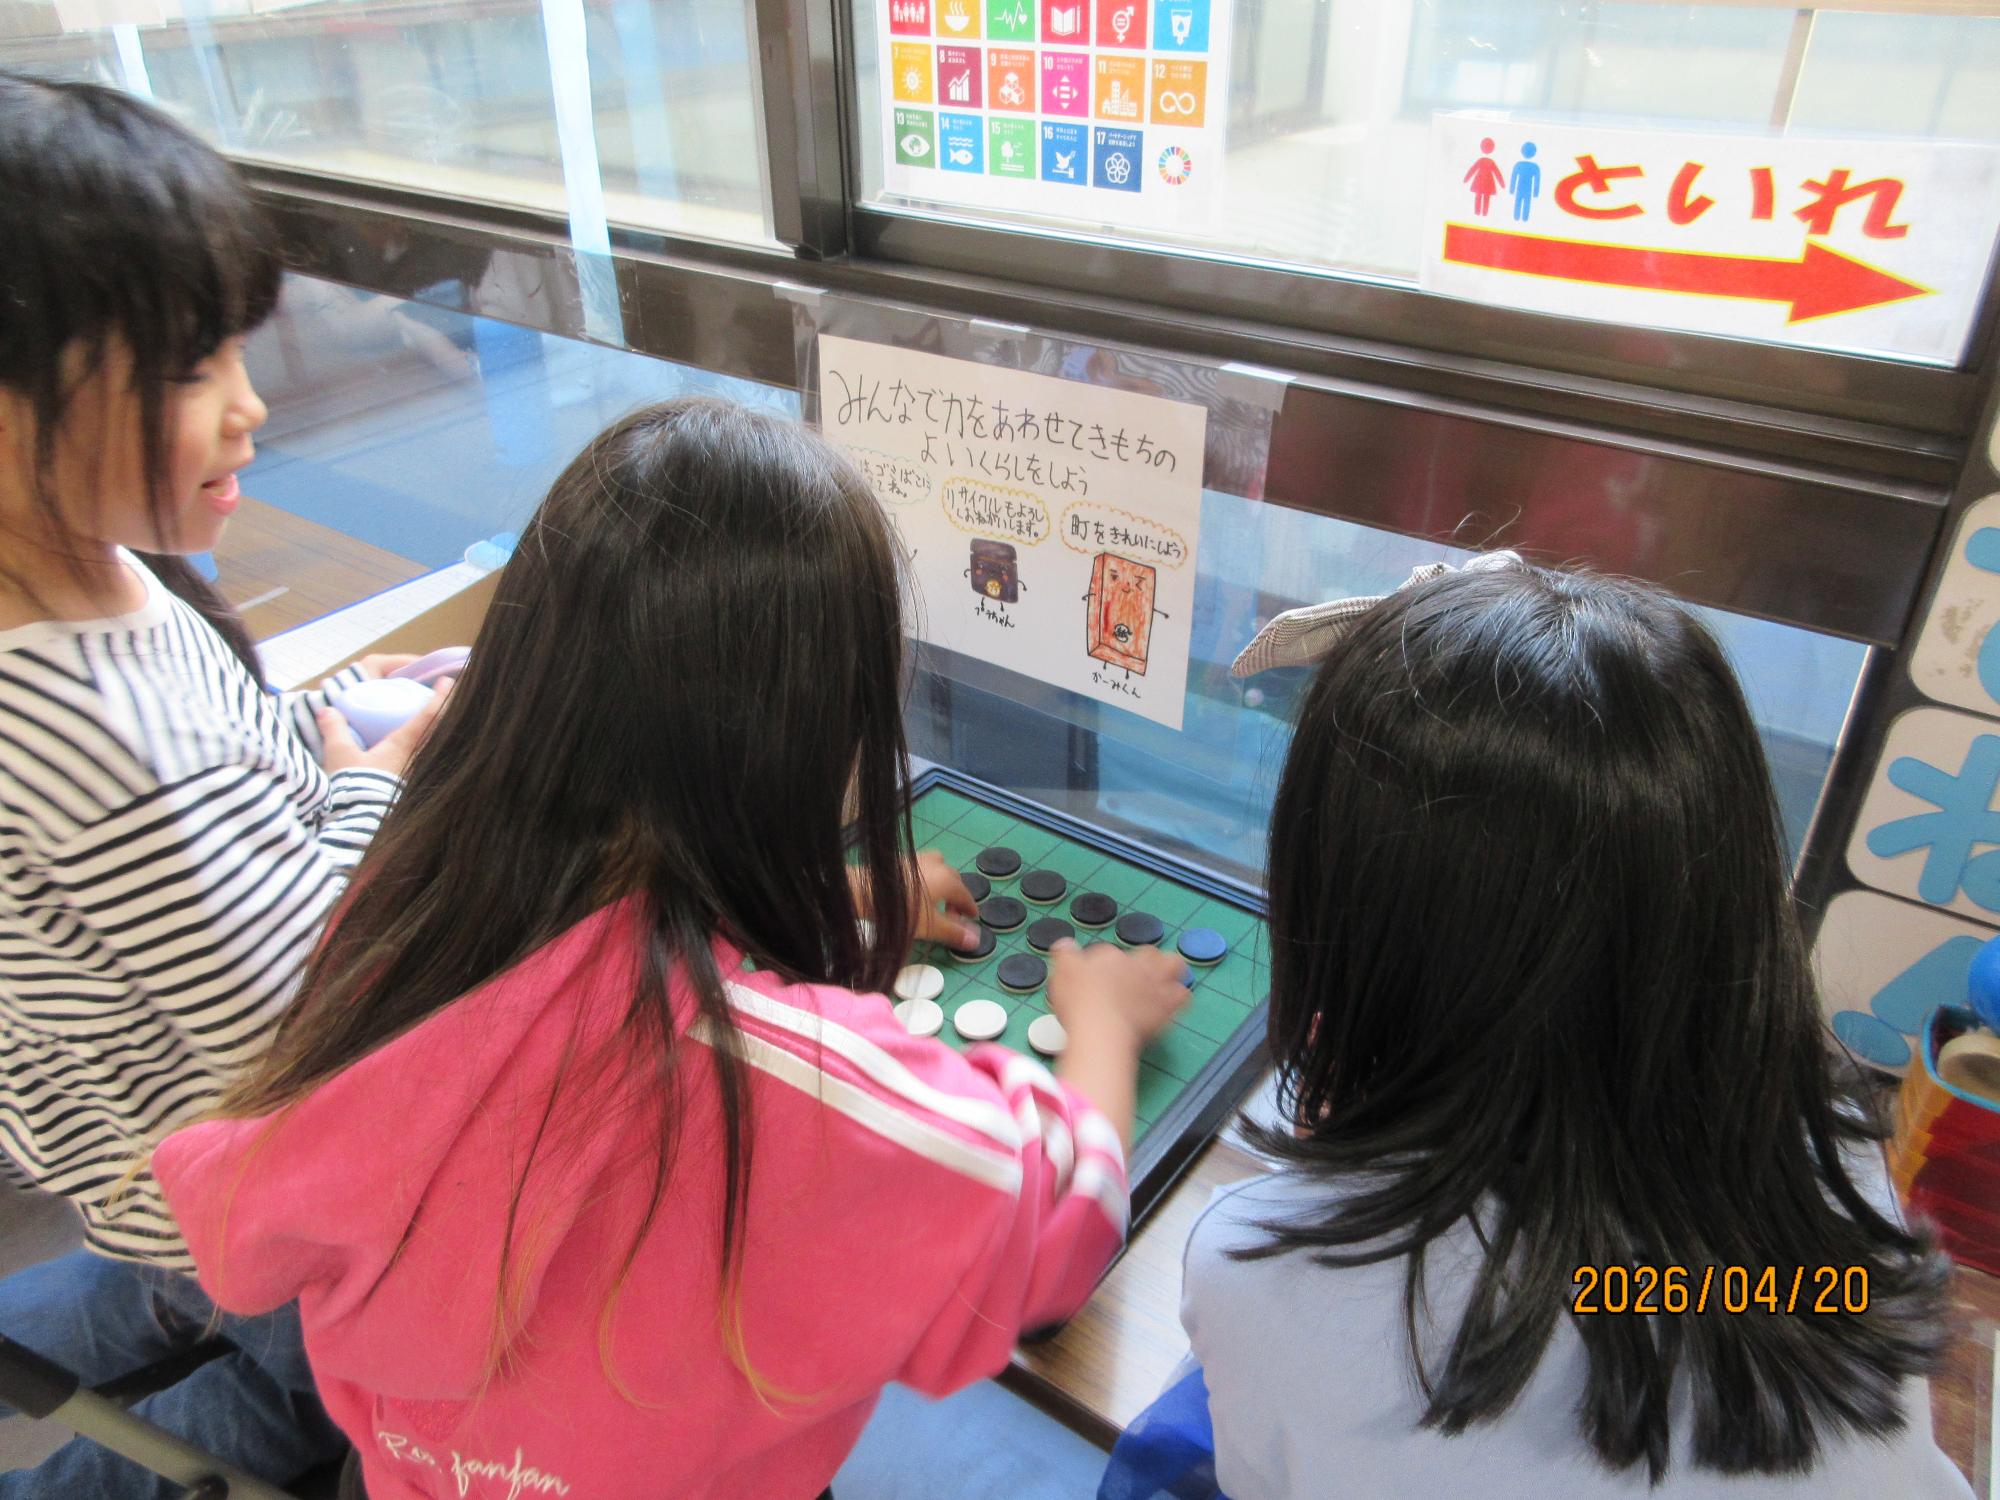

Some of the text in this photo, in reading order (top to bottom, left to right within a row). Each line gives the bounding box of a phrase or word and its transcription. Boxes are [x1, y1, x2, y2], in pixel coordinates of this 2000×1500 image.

[939, 50, 946, 63] 8
[990, 53, 997, 66] 9
[1043, 56, 1054, 70] 10
[1098, 60, 1107, 74] 11
[1154, 64, 1166, 79] 12
[896, 112, 905, 125] 13
[941, 117, 950, 130] 14
[991, 122, 1001, 135] 15
[1043, 126, 1054, 140] 16
[1097, 131, 1106, 145] 17
[1553, 153, 1910, 241] といれ
[828, 369, 1177, 474] みんなで力をあわせてきもちの
[921, 430, 1089, 496] よいくらしをしよう
[1071, 513, 1181, 559] 町をきれいにしよう
